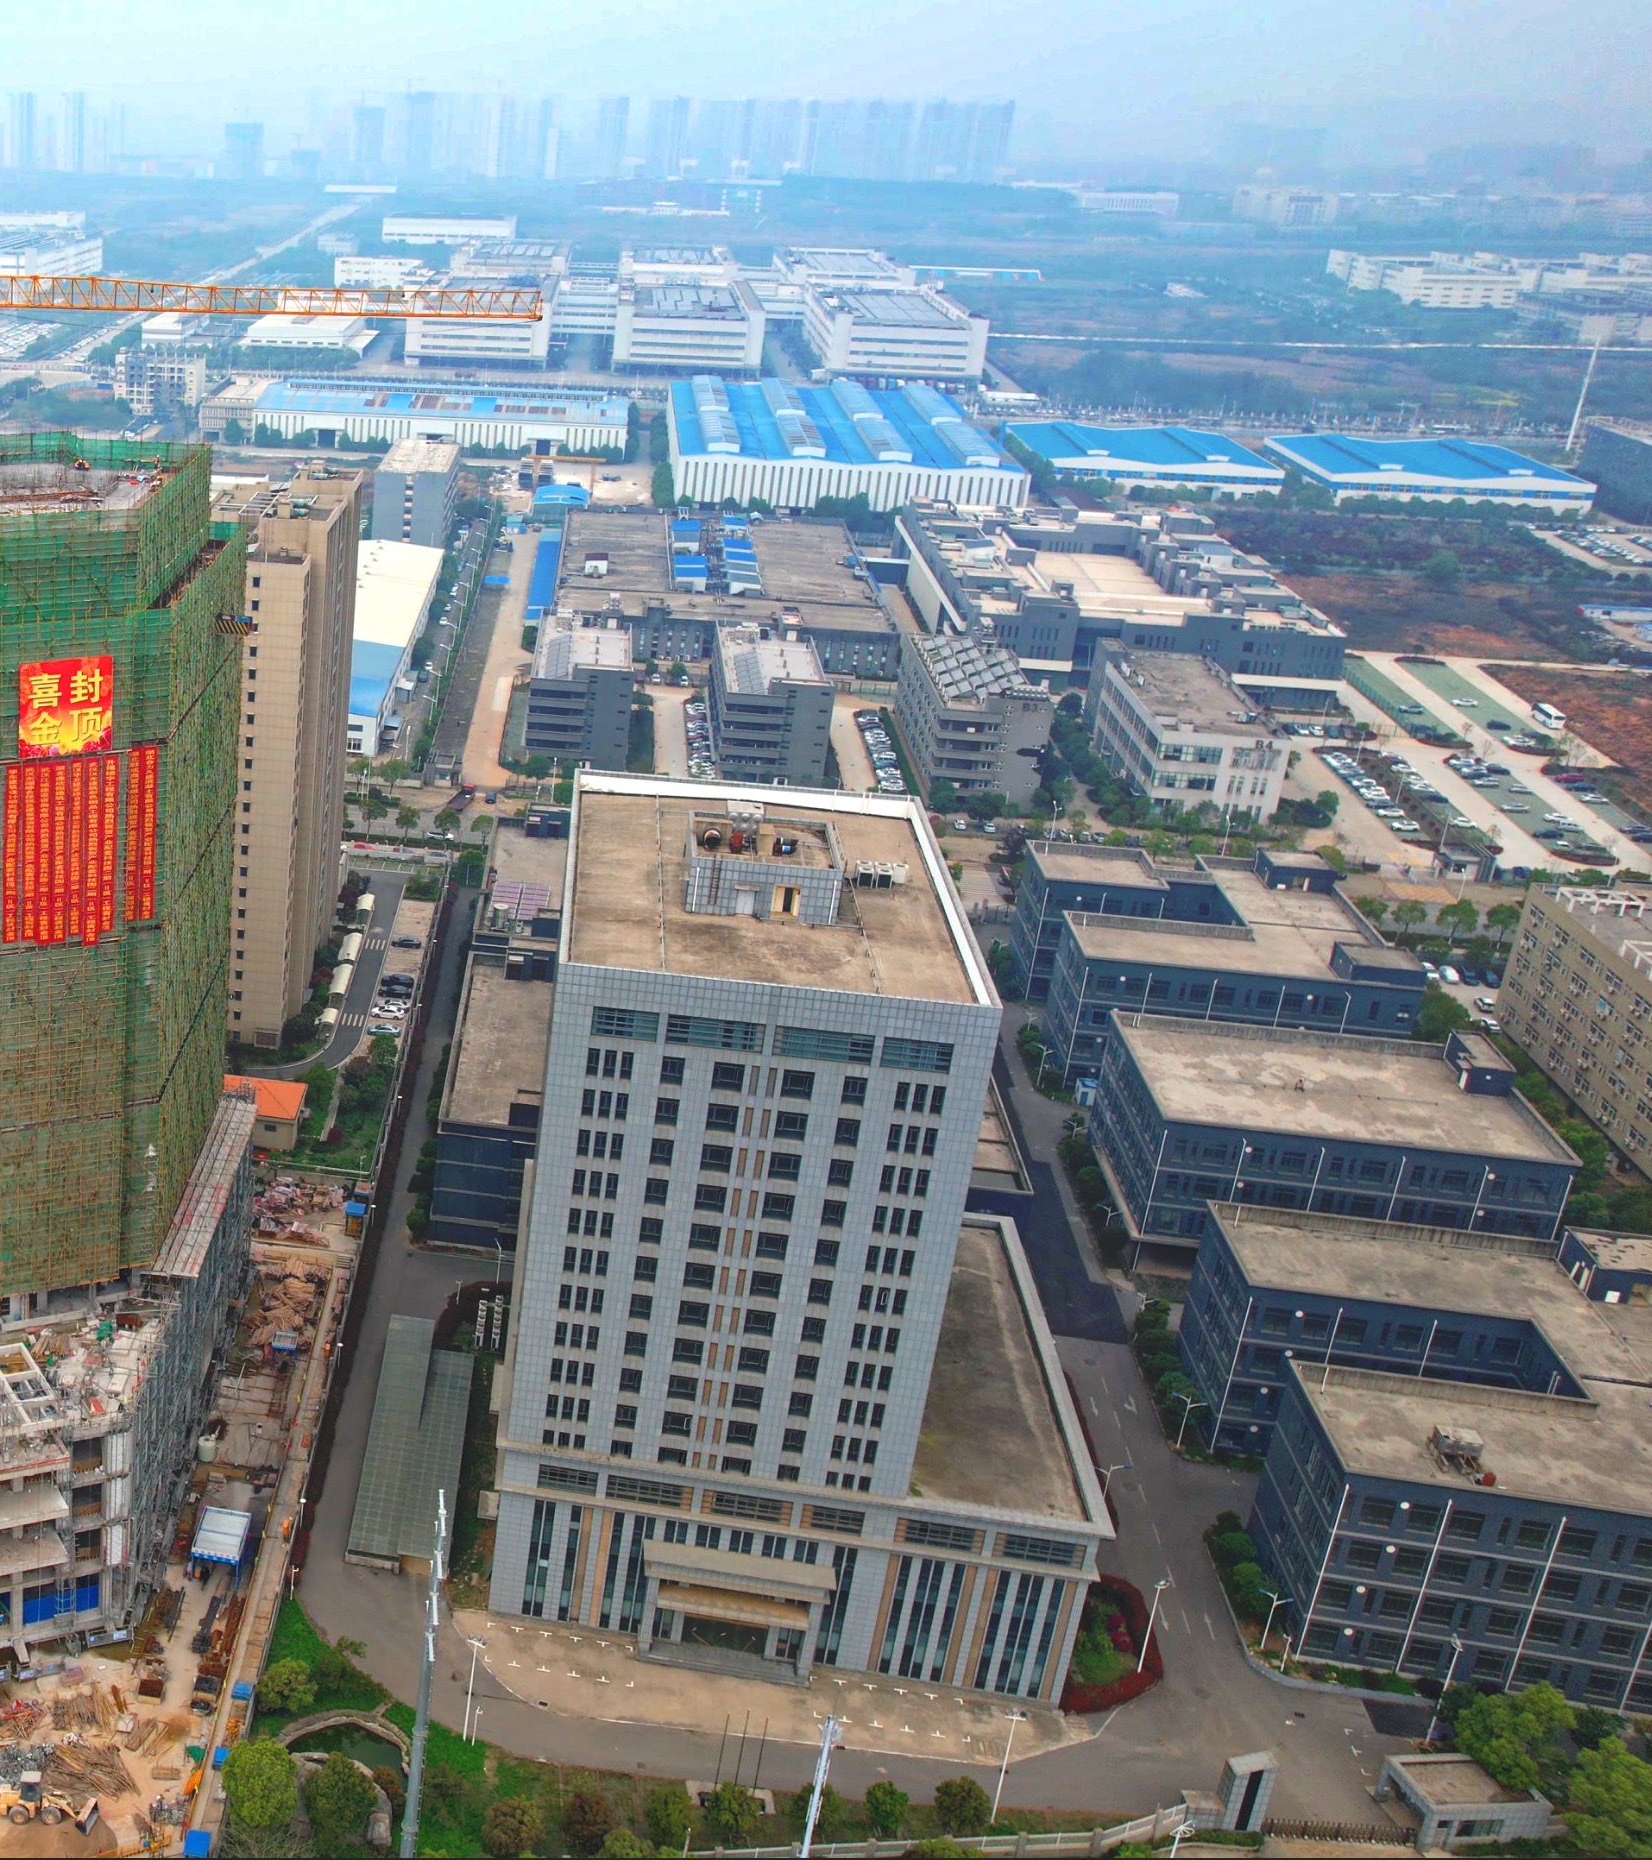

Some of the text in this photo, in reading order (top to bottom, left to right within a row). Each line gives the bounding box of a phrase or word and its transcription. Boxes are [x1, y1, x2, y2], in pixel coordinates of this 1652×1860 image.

[28, 668, 104, 709] 喜封
[28, 706, 103, 746] 金顶
[1255, 739, 1273, 750] B4
